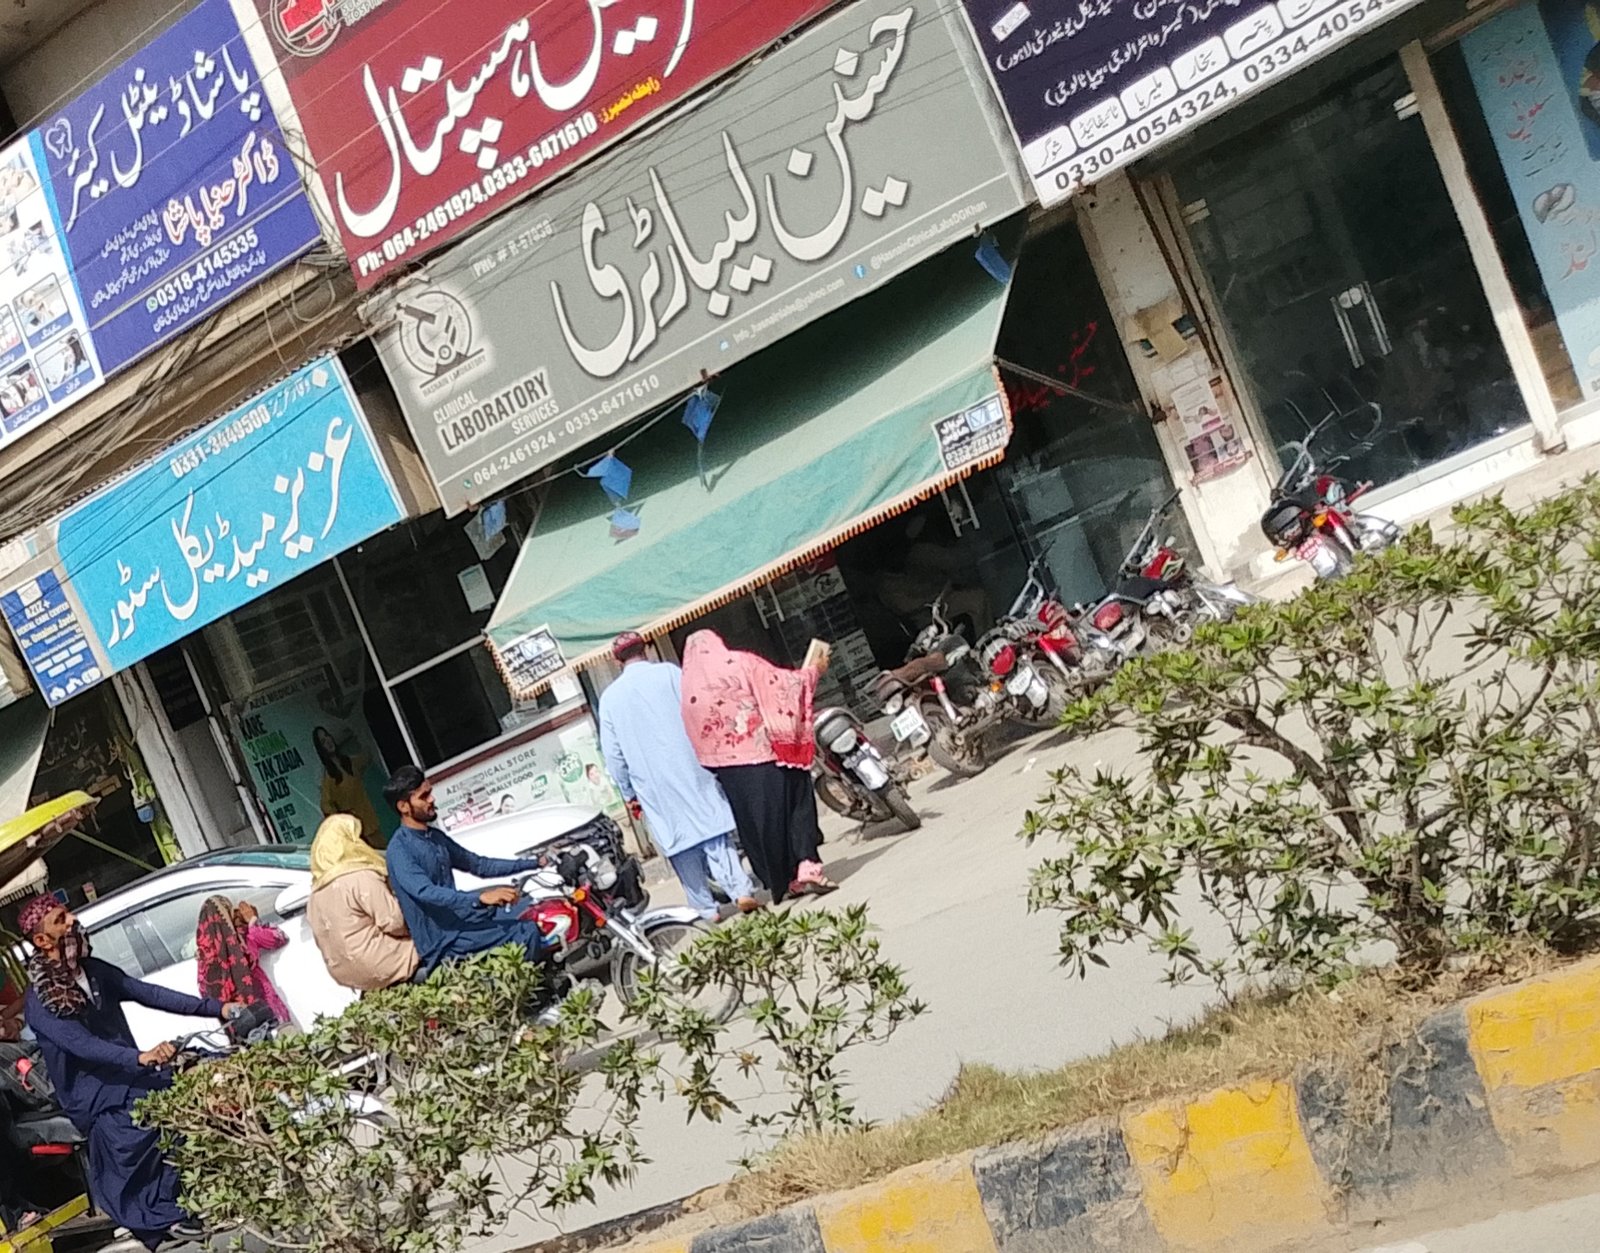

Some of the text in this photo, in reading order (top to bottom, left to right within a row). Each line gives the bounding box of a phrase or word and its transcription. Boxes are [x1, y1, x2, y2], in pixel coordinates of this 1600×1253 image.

[187, 45, 261, 122] پاشا
[765, 8, 913, 260] حسنین
[236, 131, 279, 216] ڈاکٹر
[156, 230, 260, 308] 0318-4145335
[433, 390, 479, 425] CLINICAL
[439, 371, 550, 452] LABORATORY
[473, 431, 557, 486] 064-2461924
[565, 374, 661, 435] 0333-6471610
[511, 400, 560, 435] SERVICES
[275, 416, 353, 559] عزیز
[161, 487, 275, 621] میڈیکل
[238, 714, 267, 740] KARE
[254, 748, 304, 782] TAK ZIADA
[505, 748, 537, 766] STORE
